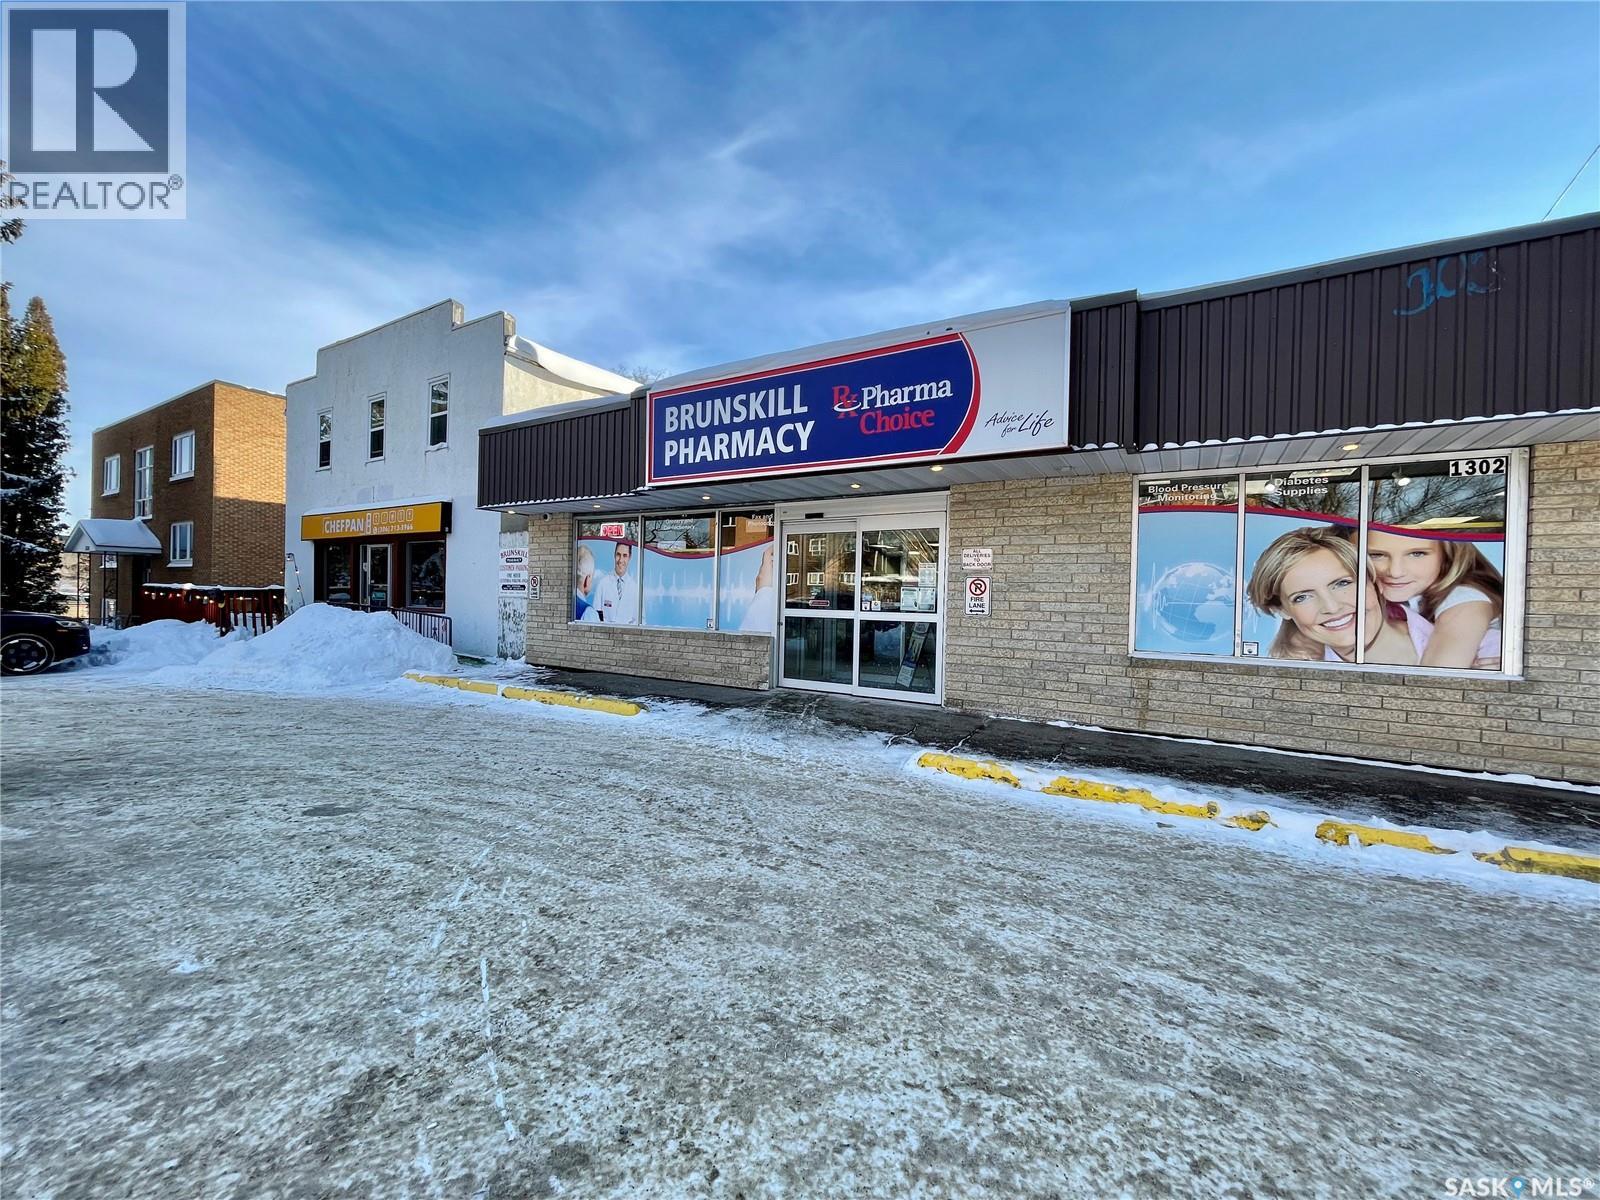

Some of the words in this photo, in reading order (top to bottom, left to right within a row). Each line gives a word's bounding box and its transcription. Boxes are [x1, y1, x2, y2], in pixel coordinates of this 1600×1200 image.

[860, 379, 953, 410] Pharma
[665, 384, 808, 433] BRUNSKILL
[859, 406, 935, 435] Choice
[984, 411, 1024, 428] Advice
[1001, 424, 1017, 437] for
[1018, 409, 1055, 436] Life
[664, 420, 815, 466] PHARMACY
[1450, 459, 1505, 477] 1302
[1148, 484, 1179, 494] Blood
[1181, 482, 1228, 493] Pressure
[1274, 477, 1329, 487] Diabetes
[1157, 493, 1217, 502] Monitoring
[1274, 486, 1329, 497] Supplies
[324, 518, 364, 534] CHEFPAN
[602, 525, 624, 537] OPEN
